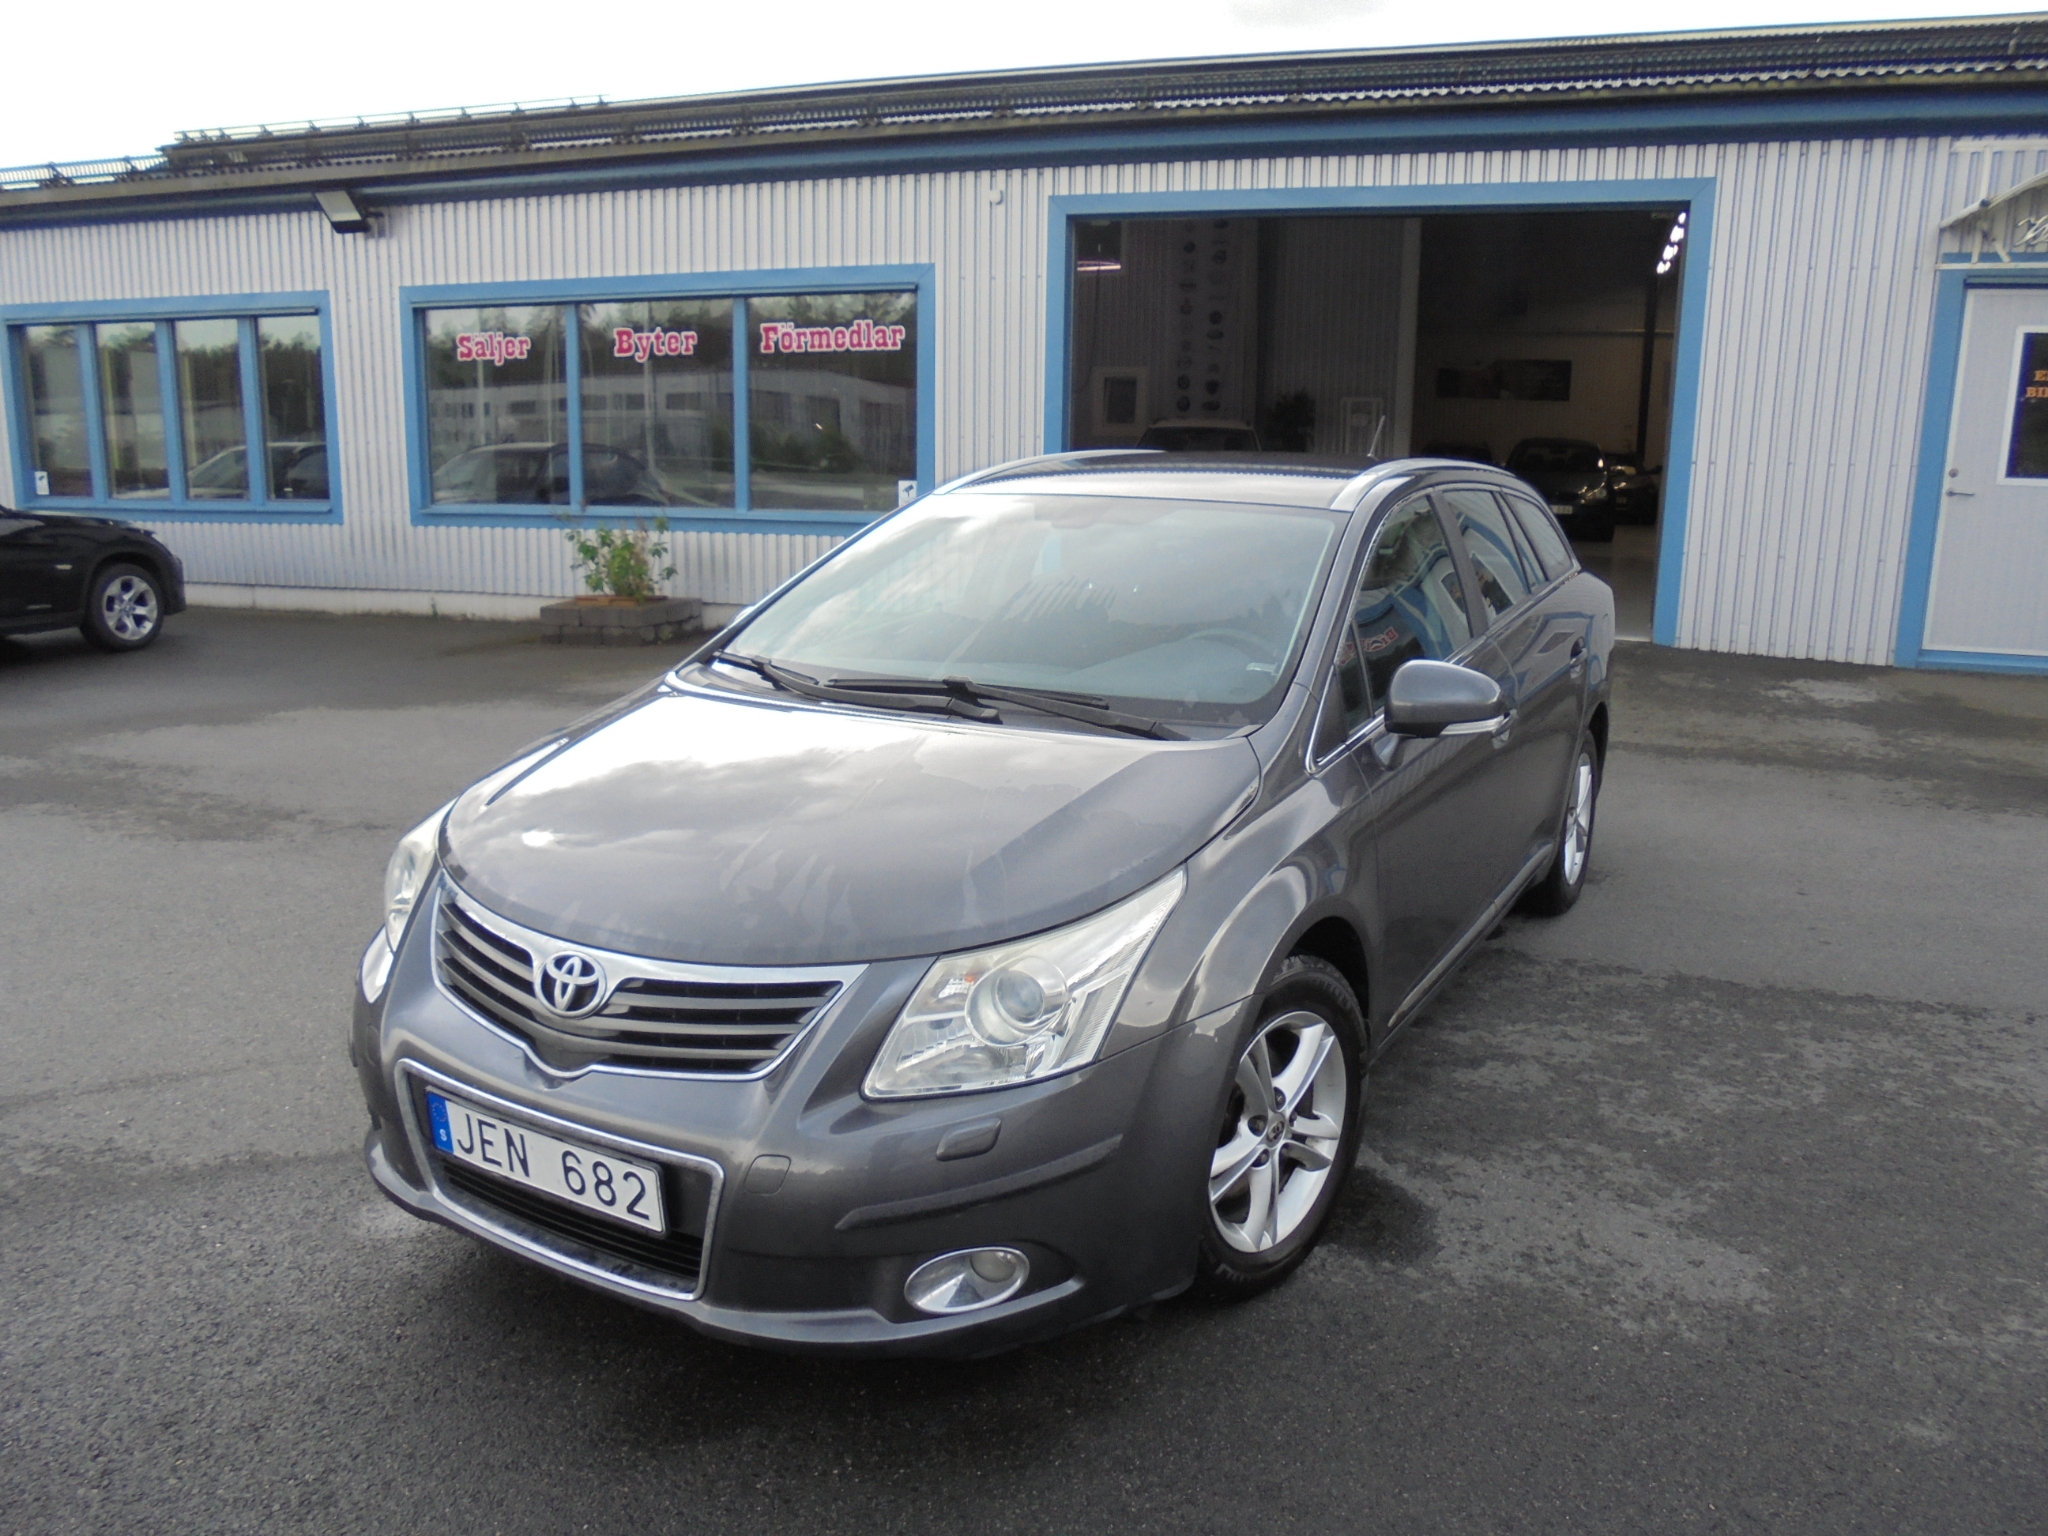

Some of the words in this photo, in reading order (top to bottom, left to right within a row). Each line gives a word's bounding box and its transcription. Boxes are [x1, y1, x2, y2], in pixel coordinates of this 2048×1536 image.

[457, 332, 531, 366] Säljer
[614, 327, 697, 362] Byter
[760, 320, 905, 353] Förmedlar
[457, 1113, 530, 1178] JEN
[561, 1150, 650, 1221] 682
